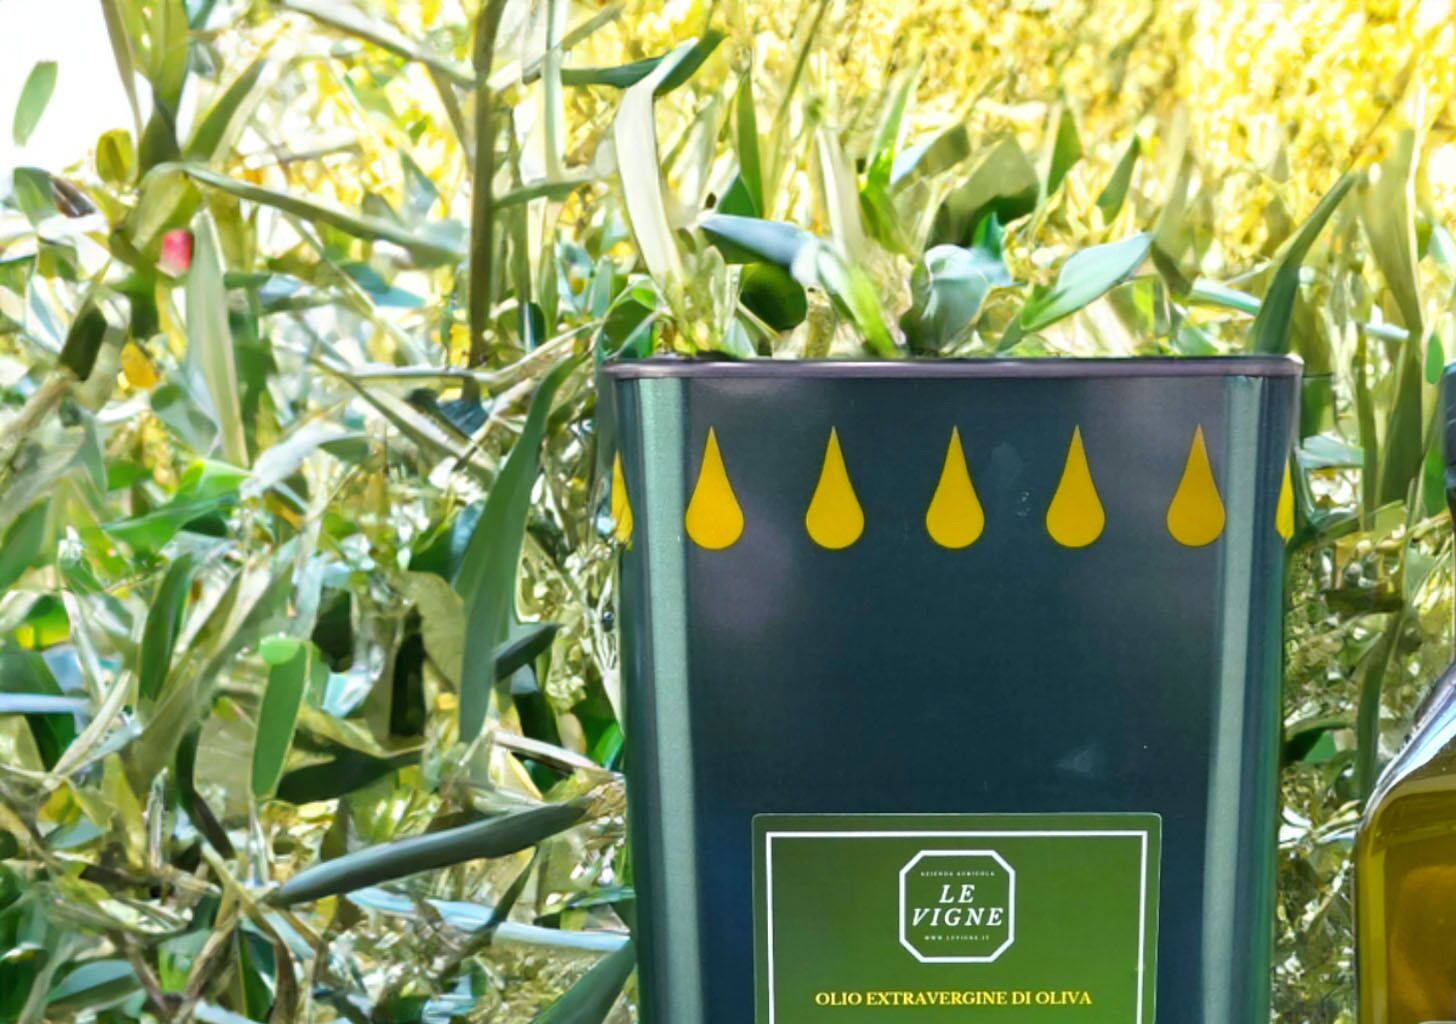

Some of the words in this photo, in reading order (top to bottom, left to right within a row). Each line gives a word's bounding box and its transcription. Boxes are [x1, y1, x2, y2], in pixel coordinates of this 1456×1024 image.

[938, 884, 976, 904] LE
[912, 907, 1004, 927] VIGNE
[815, 991, 863, 1006] OLIO
[866, 991, 1008, 1006] EXTRAVERGINE
[1011, 991, 1031, 1006] DI
[1035, 990, 1093, 1005] OLIVA
